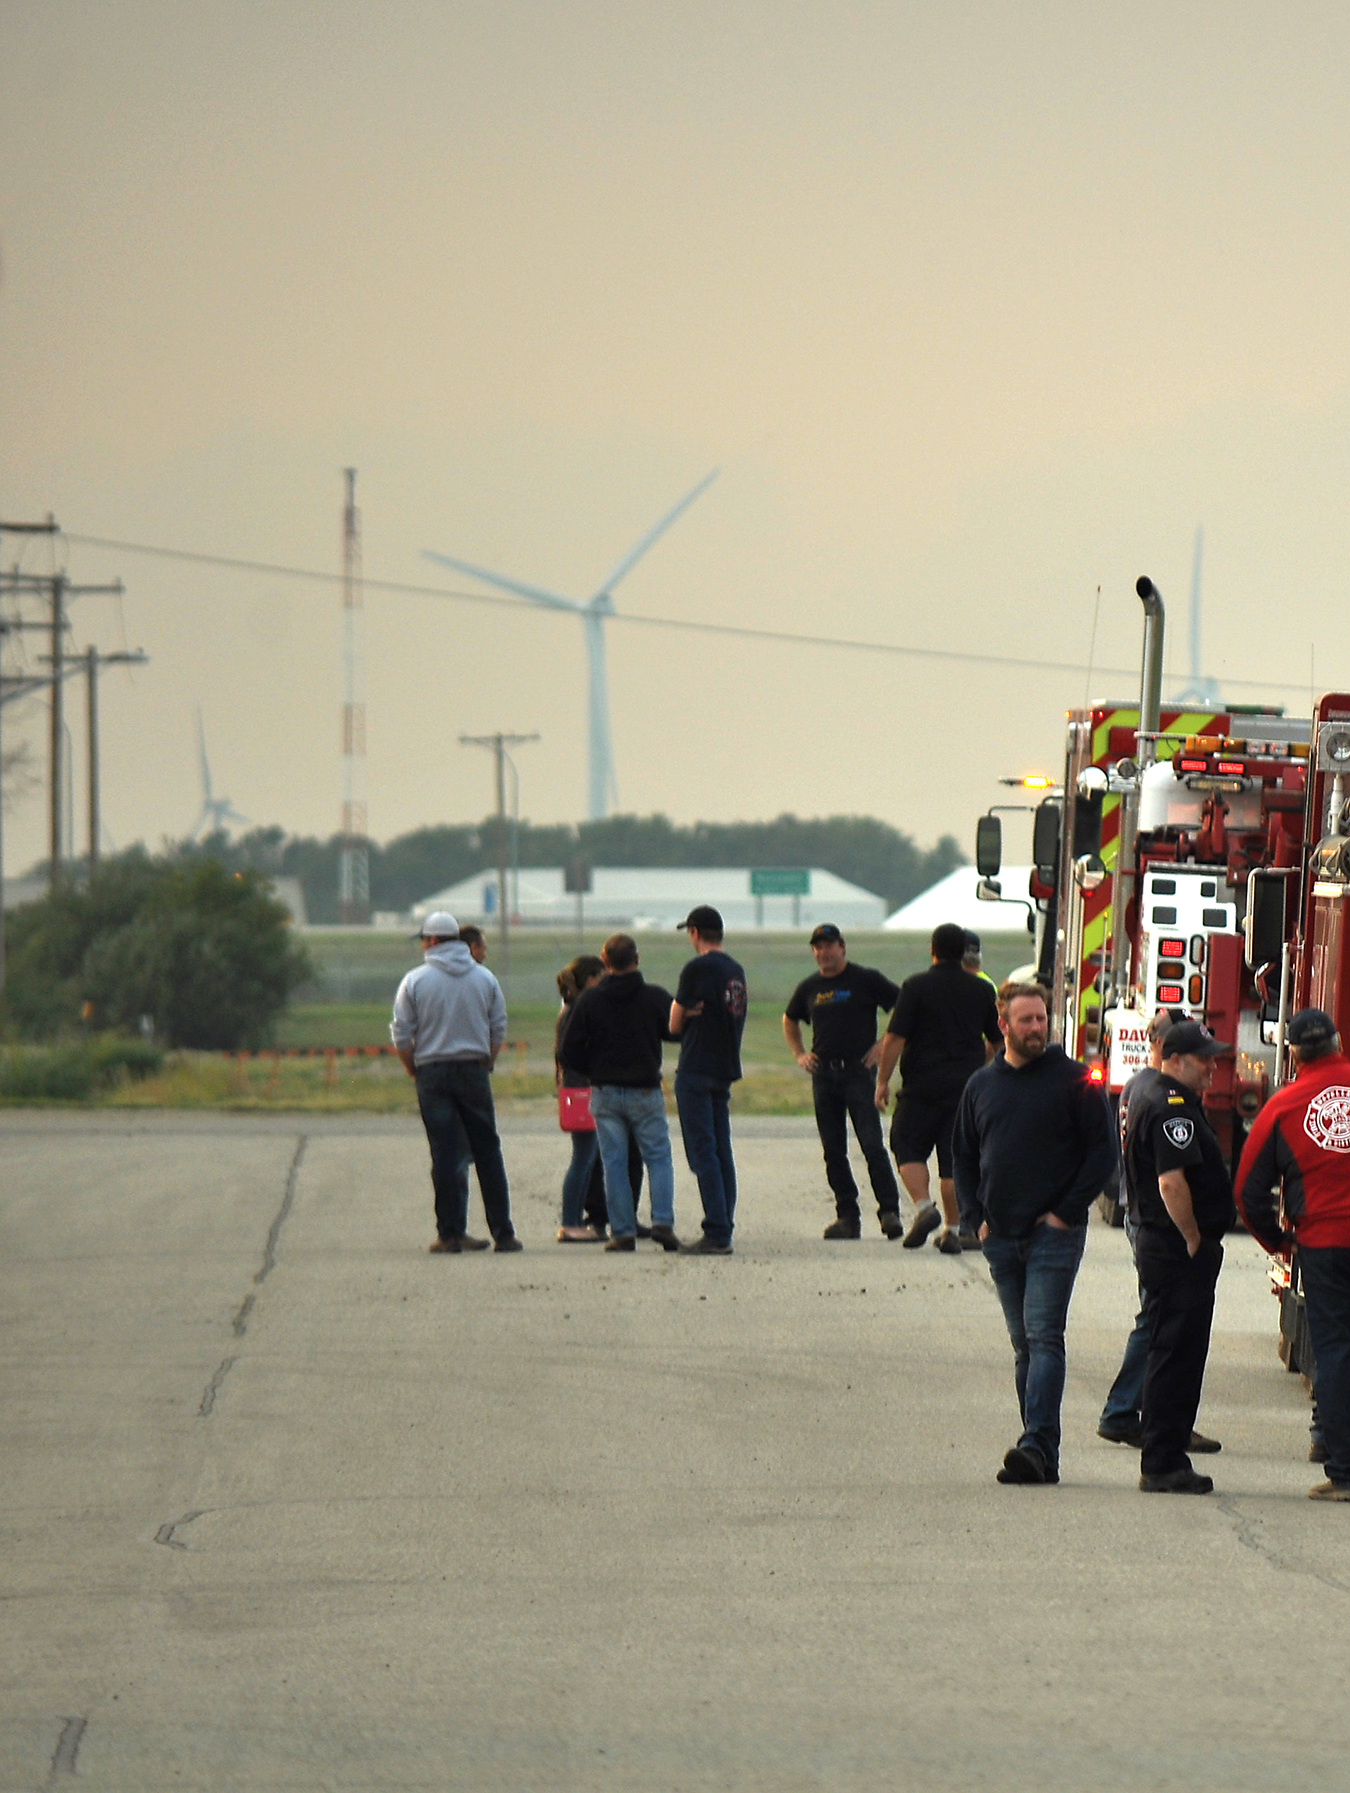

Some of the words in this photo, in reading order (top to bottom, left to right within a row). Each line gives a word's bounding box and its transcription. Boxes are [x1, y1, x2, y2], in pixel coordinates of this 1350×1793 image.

[1118, 1028, 1149, 1042] DAV
[1121, 1042, 1147, 1053] TRUCK
[1122, 1053, 1150, 1066] 306-4
